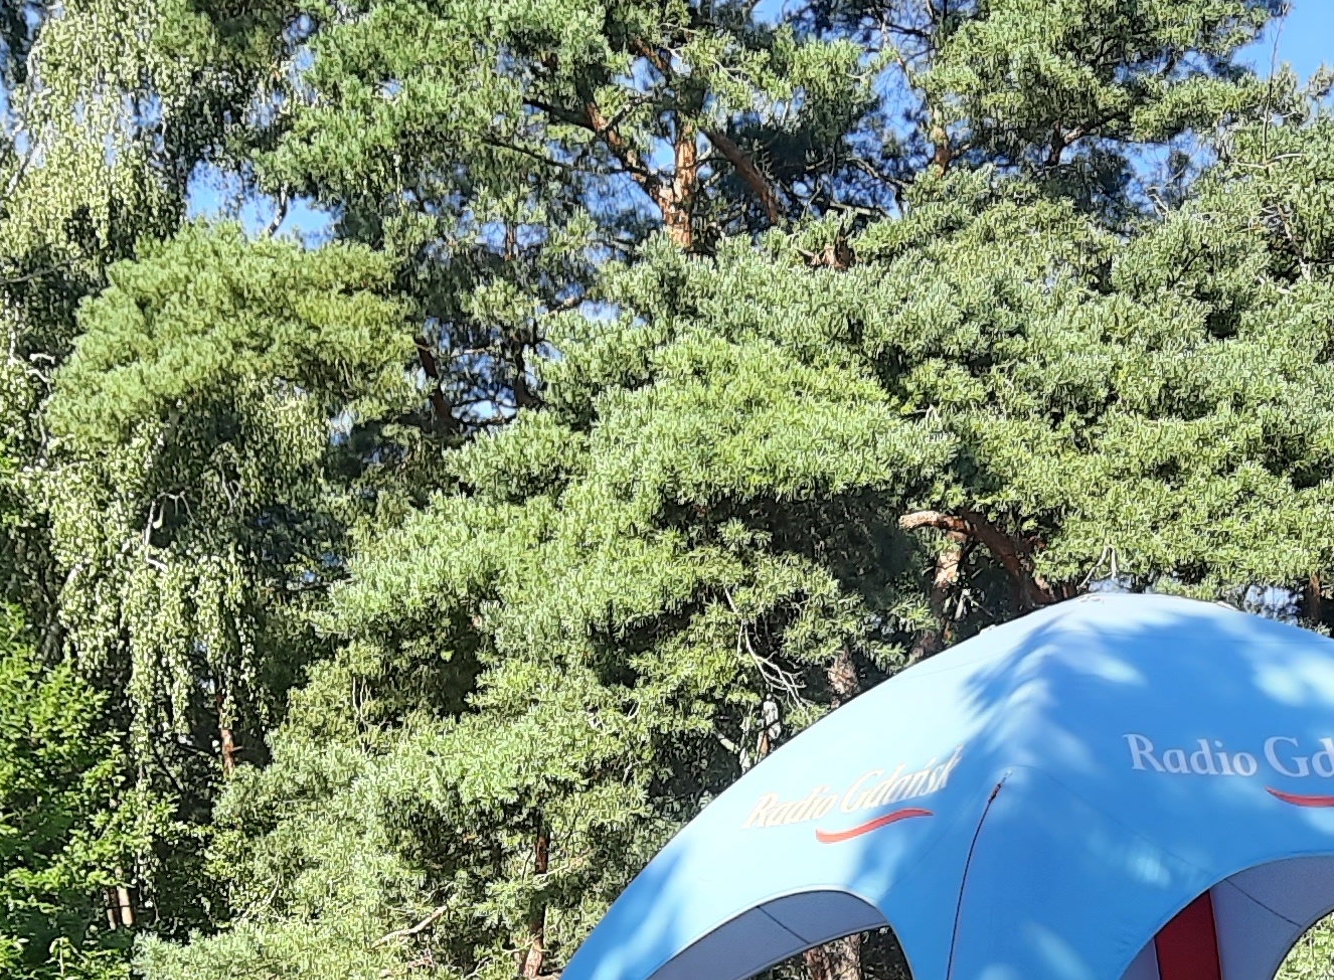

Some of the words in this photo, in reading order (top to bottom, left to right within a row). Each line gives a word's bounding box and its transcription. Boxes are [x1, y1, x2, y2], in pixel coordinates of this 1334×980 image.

[741, 785, 838, 830] Radio
[839, 744, 964, 814] Gdańsk
[1122, 732, 1258, 777] Radio
